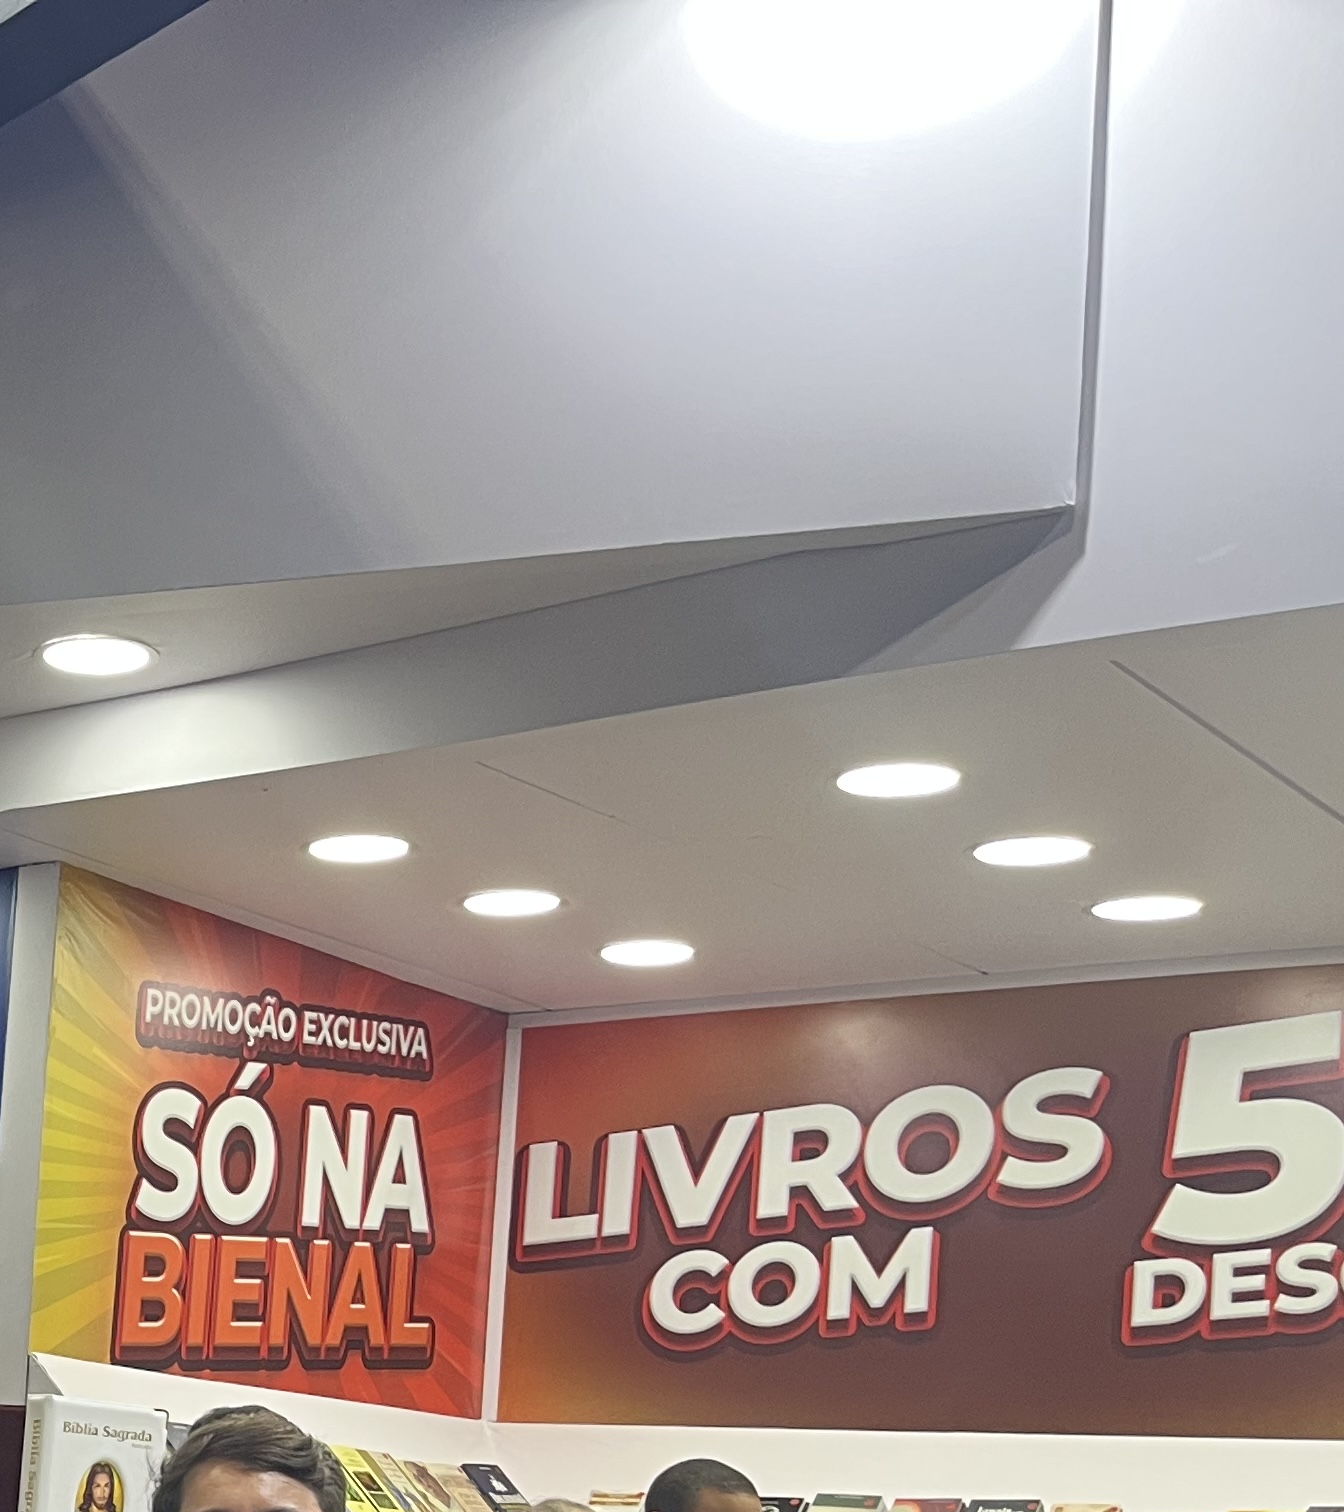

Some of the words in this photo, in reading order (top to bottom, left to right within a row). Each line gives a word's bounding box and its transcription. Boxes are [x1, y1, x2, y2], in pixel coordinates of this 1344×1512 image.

[145, 986, 297, 1047] PROMOÇÃO
[302, 1009, 429, 1061] EXCLUSIVA
[134, 1062, 278, 1227] SÓ
[299, 1103, 430, 1235] NA
[521, 1066, 1106, 1248] LIVROS
[118, 1230, 431, 1352] BIENAL
[647, 1225, 936, 1336] COM
[1130, 1243, 1344, 1329] DES
[101, 1425, 153, 1443] Sagrada
